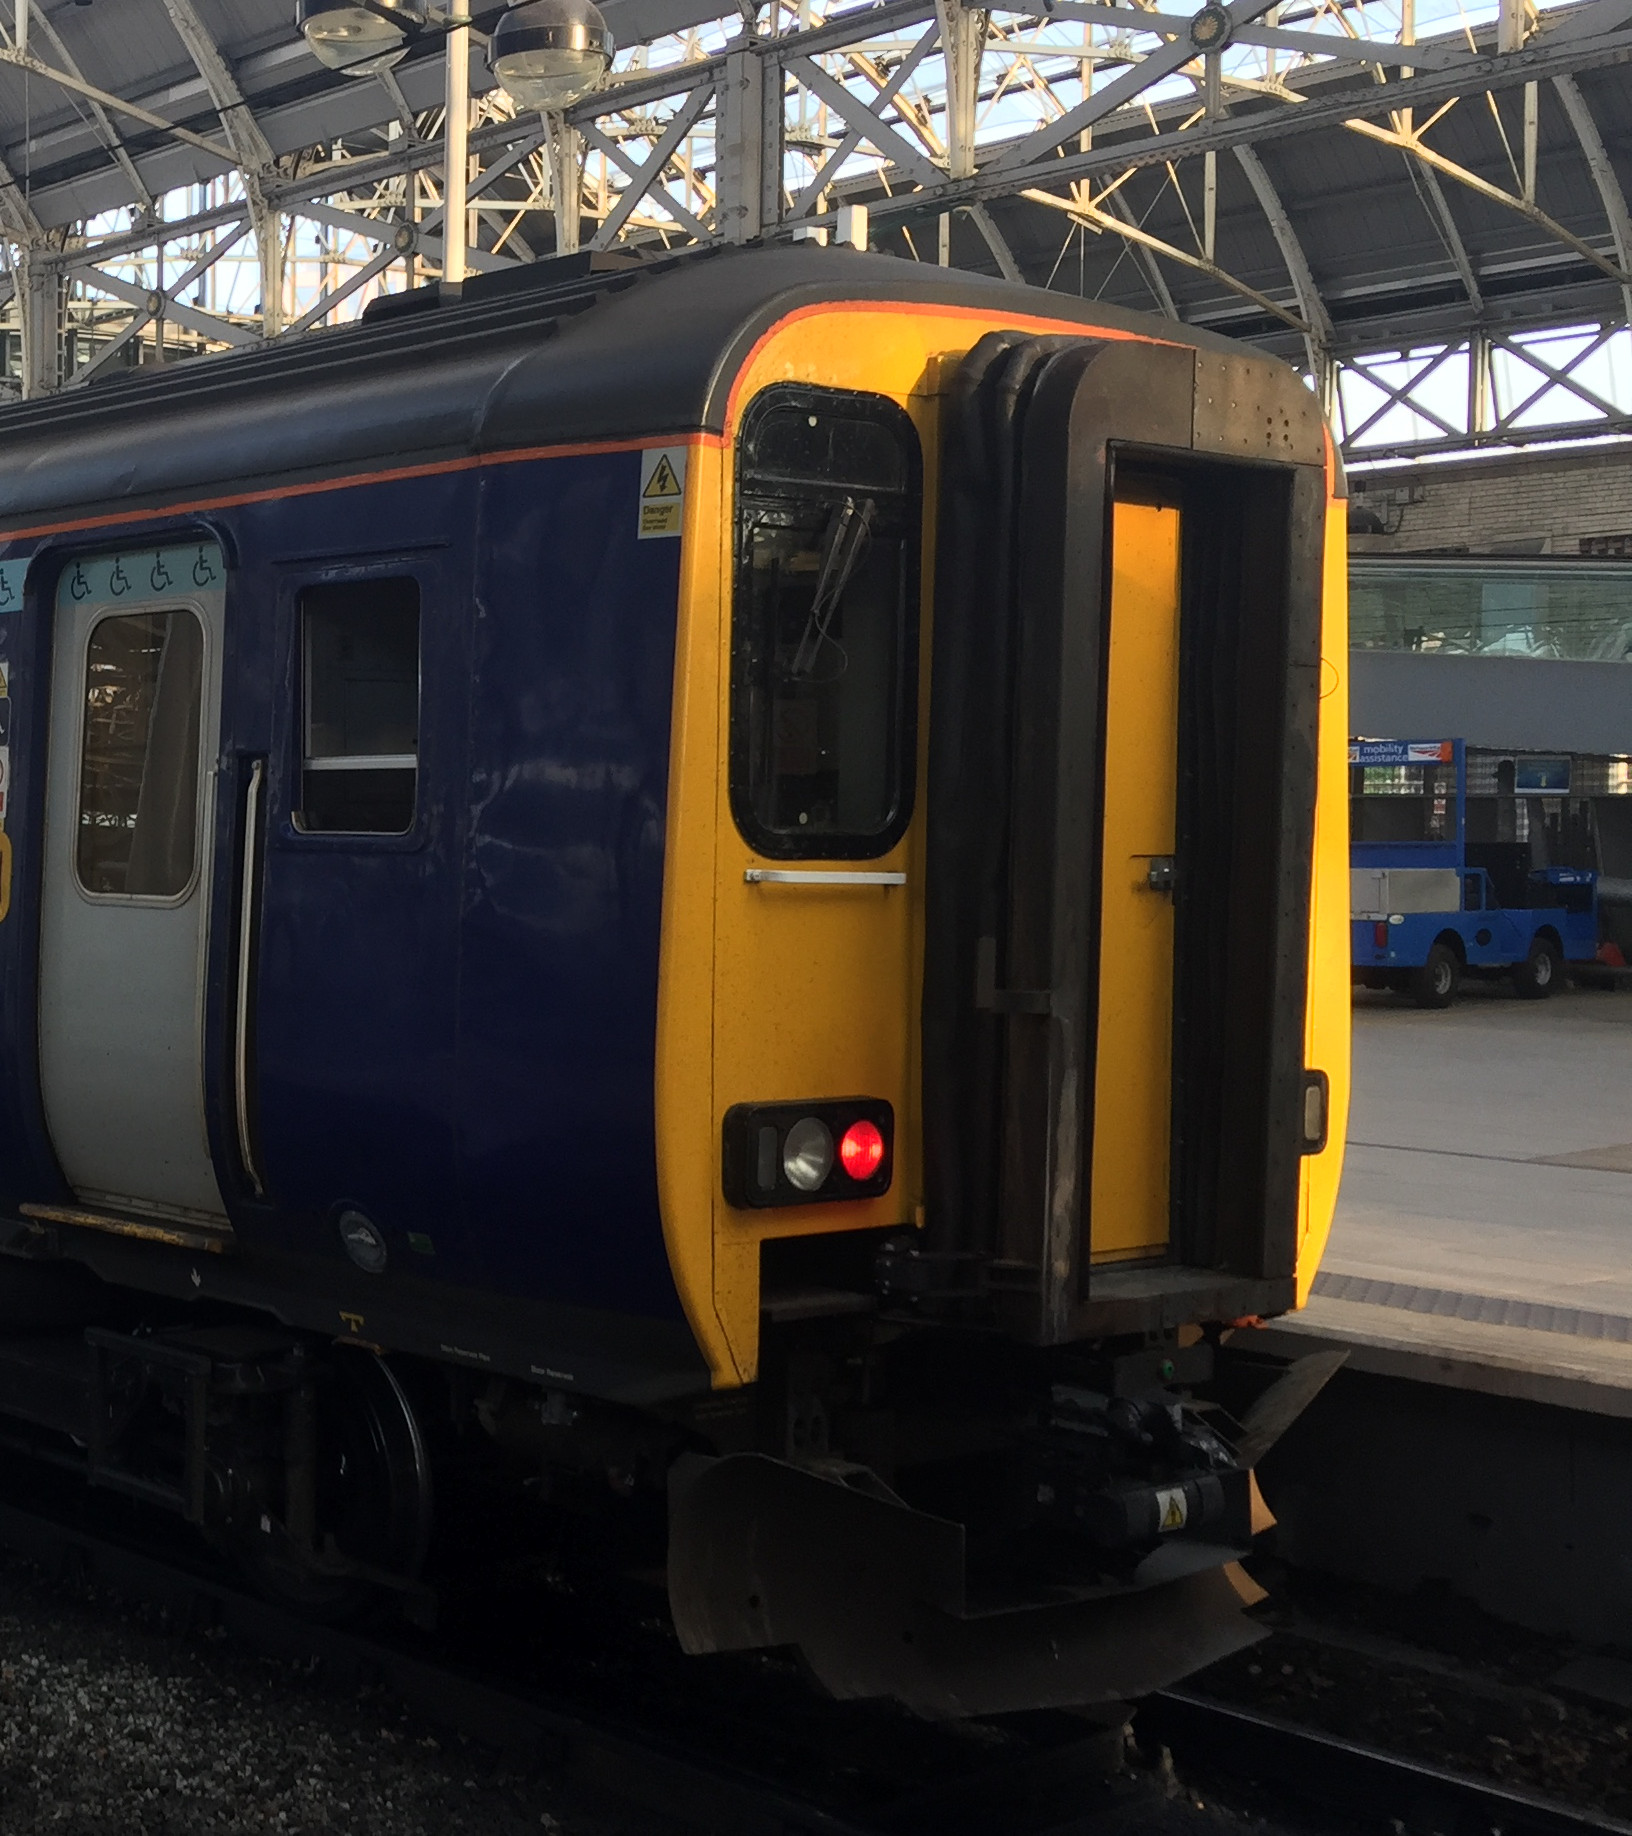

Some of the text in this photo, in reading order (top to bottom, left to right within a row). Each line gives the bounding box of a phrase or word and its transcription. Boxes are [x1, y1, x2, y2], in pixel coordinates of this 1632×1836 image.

[643, 505, 674, 516] Danger
[1363, 744, 1404, 754] mobility
[1359, 753, 1408, 763] assistance
